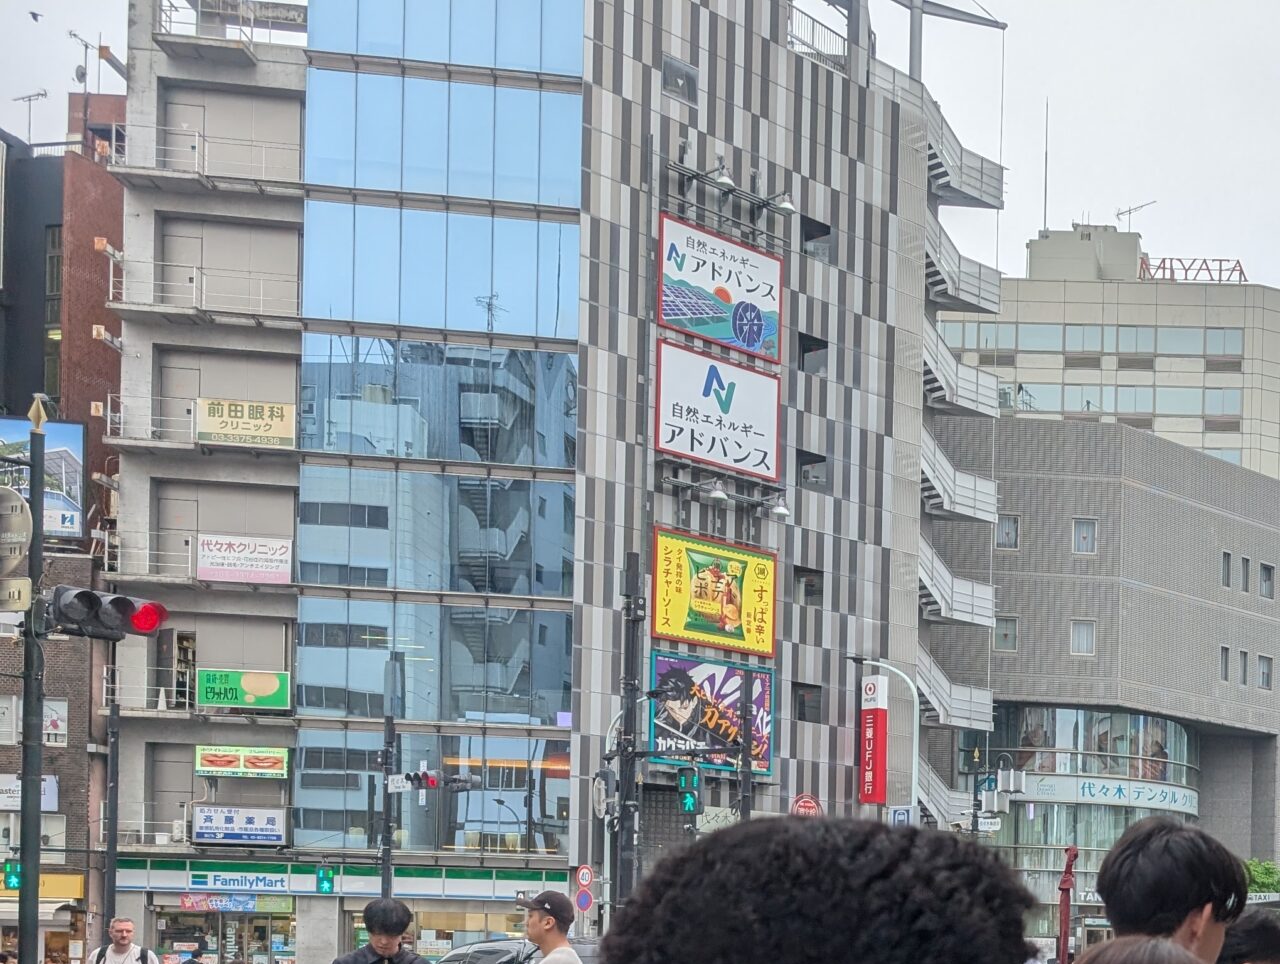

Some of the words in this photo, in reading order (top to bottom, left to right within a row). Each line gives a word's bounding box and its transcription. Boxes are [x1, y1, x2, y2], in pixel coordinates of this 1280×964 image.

[686, 236, 759, 269] 自然エネルギー
[690, 255, 776, 301] アドバンス
[1138, 257, 1249, 283] MIYATA
[207, 401, 285, 422] 前田眼科
[219, 420, 273, 432] クリニック
[672, 402, 765, 438] 自然エネルギー
[664, 422, 771, 471] アドバンス
[200, 539, 289, 557] 代々木クリニック
[661, 546, 673, 628] シラチャーソース
[753, 585, 769, 645] すっぱ辛い
[865, 714, 874, 795] 三菱UFJ銀行
[1081, 781, 1127, 799] 代々木
[1132, 786, 1178, 804] デンタル
[213, 875, 285, 888] FamilyMart
[581, 871, 590, 881] 40
